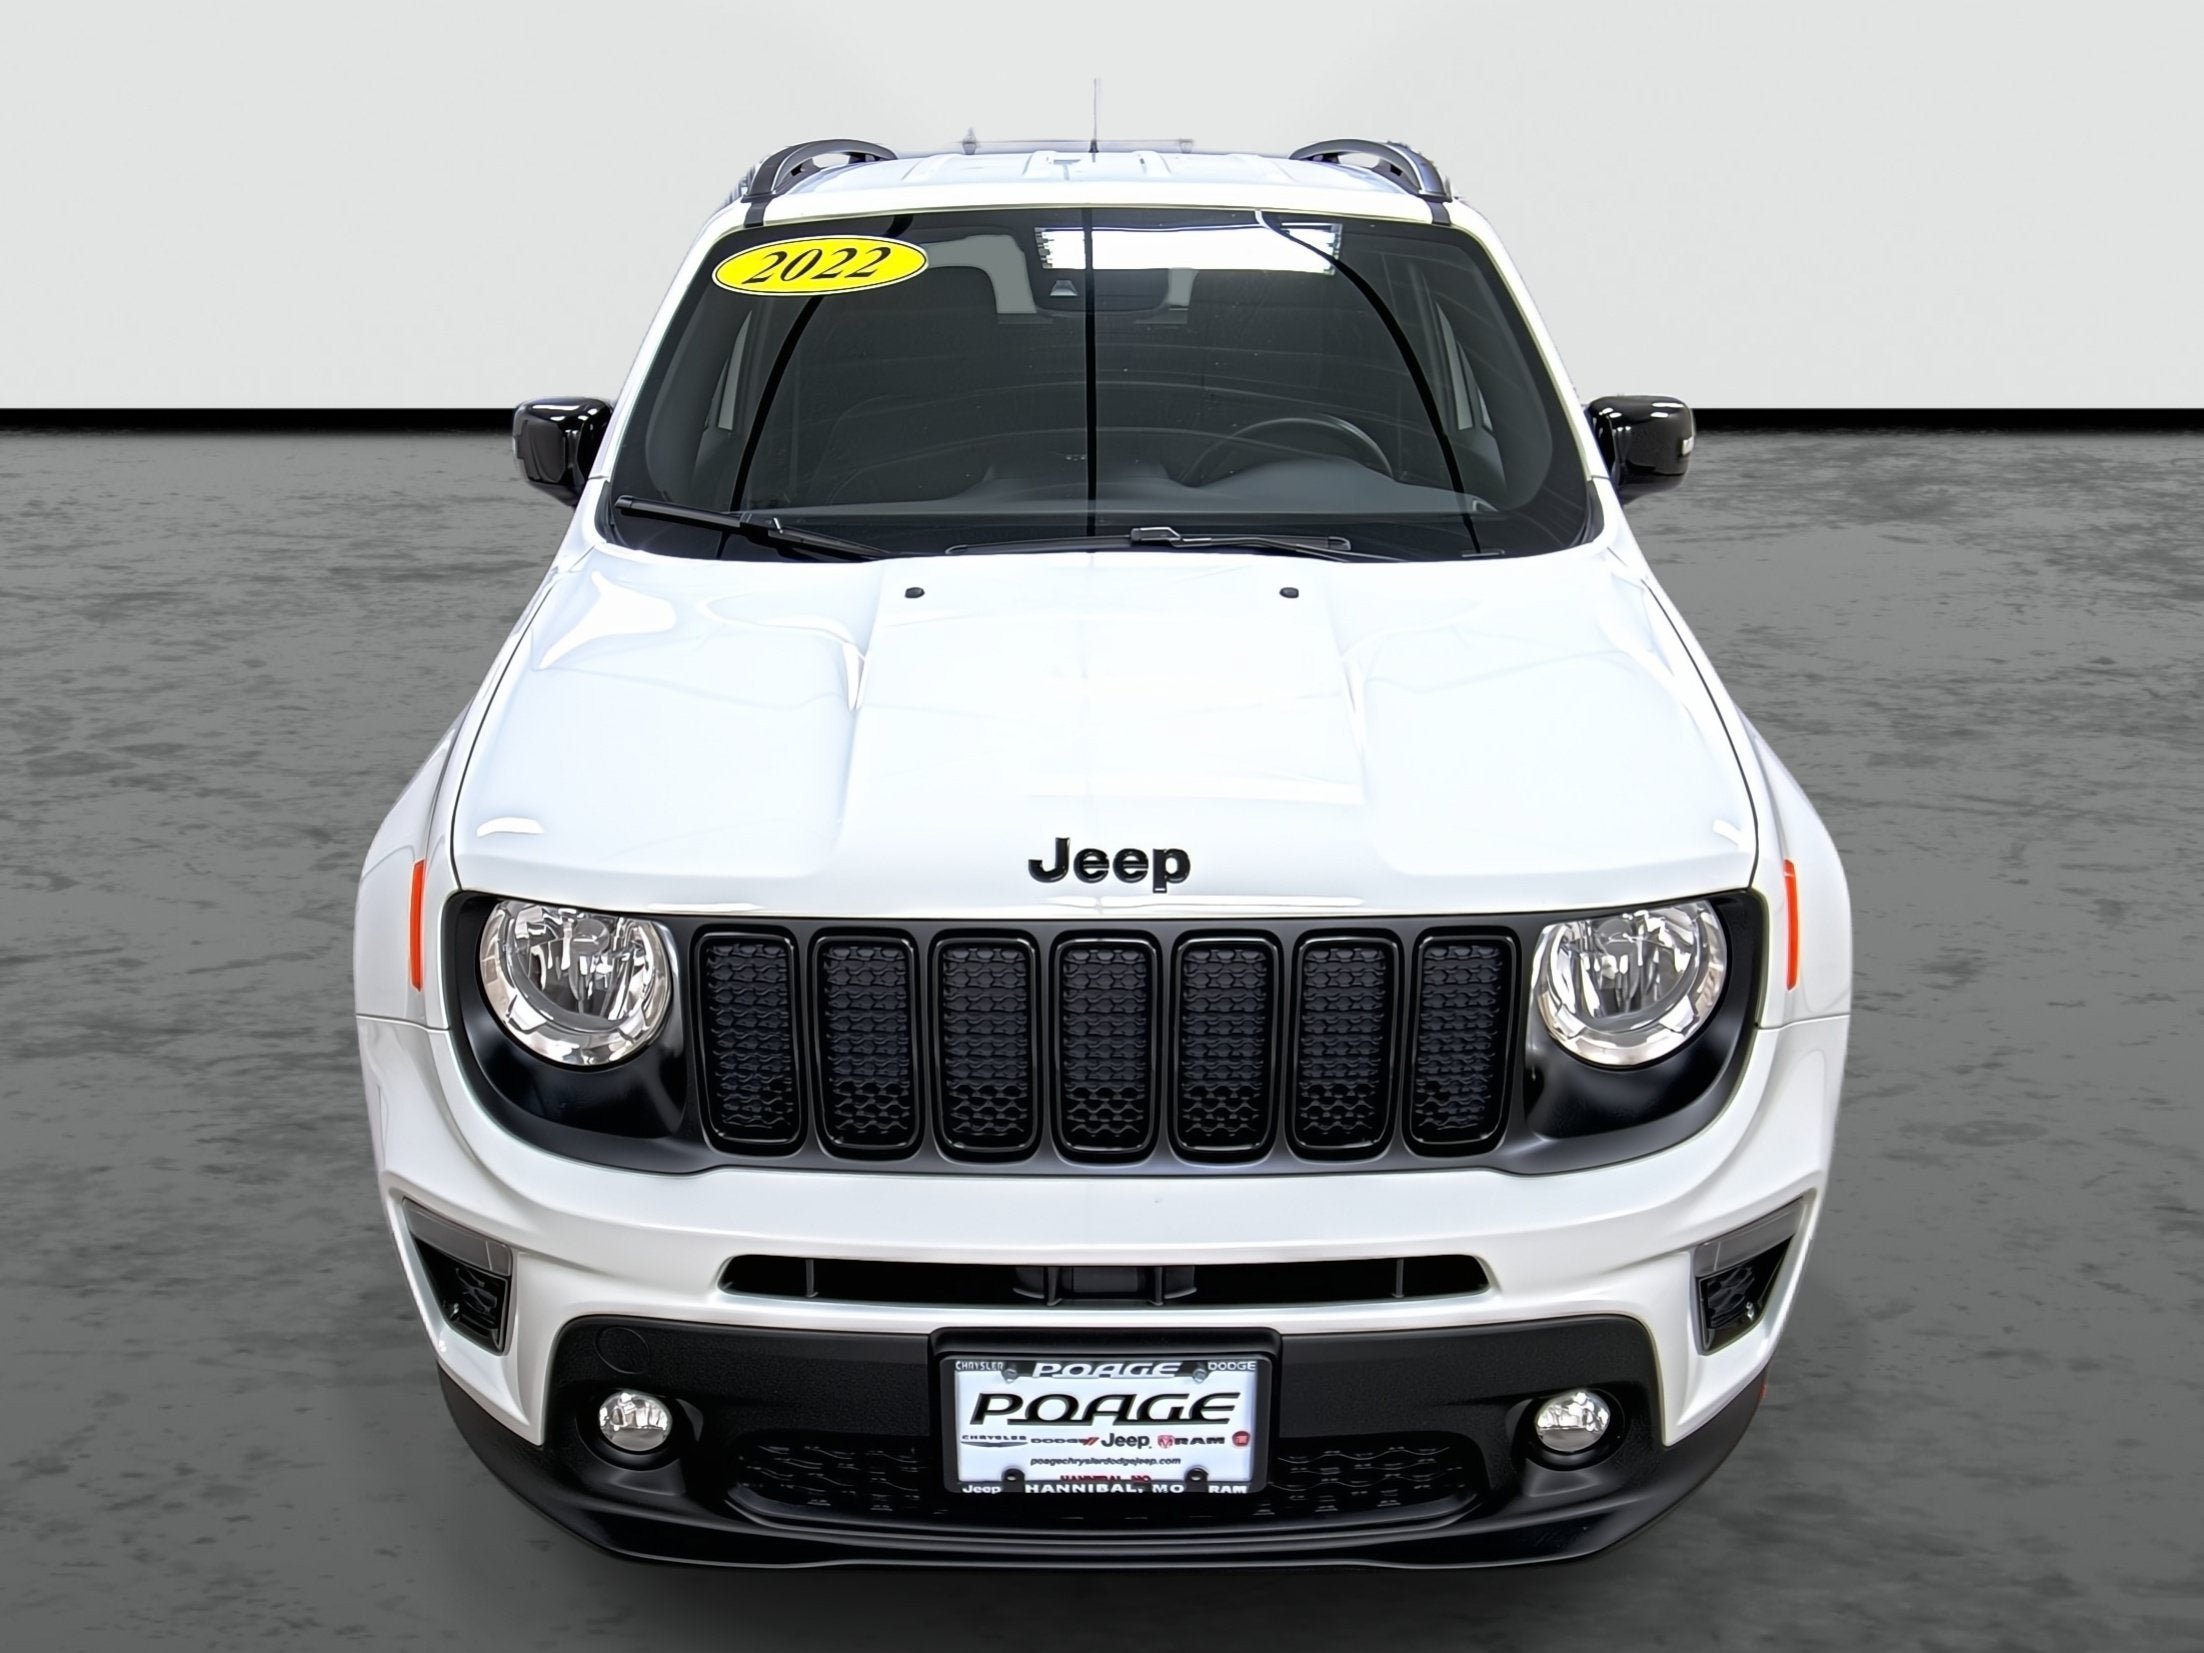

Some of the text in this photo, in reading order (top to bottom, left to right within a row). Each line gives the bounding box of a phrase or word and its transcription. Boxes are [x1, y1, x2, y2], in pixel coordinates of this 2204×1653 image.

[741, 246, 892, 285] 2022
[1028, 837, 1191, 894] Jeep
[955, 1361, 1004, 1371] CHRYSLER
[1031, 1362, 1182, 1378] POAGE
[1207, 1361, 1257, 1371] DODGE
[969, 1392, 1241, 1426] POAGE
[1101, 1433, 1151, 1449] Jeep
[1174, 1437, 1226, 1445] RAM
[962, 1484, 1002, 1494] Jeep
[1025, 1484, 1185, 1494] HANNIBAL, MO
[1208, 1484, 1248, 1494] RAM
